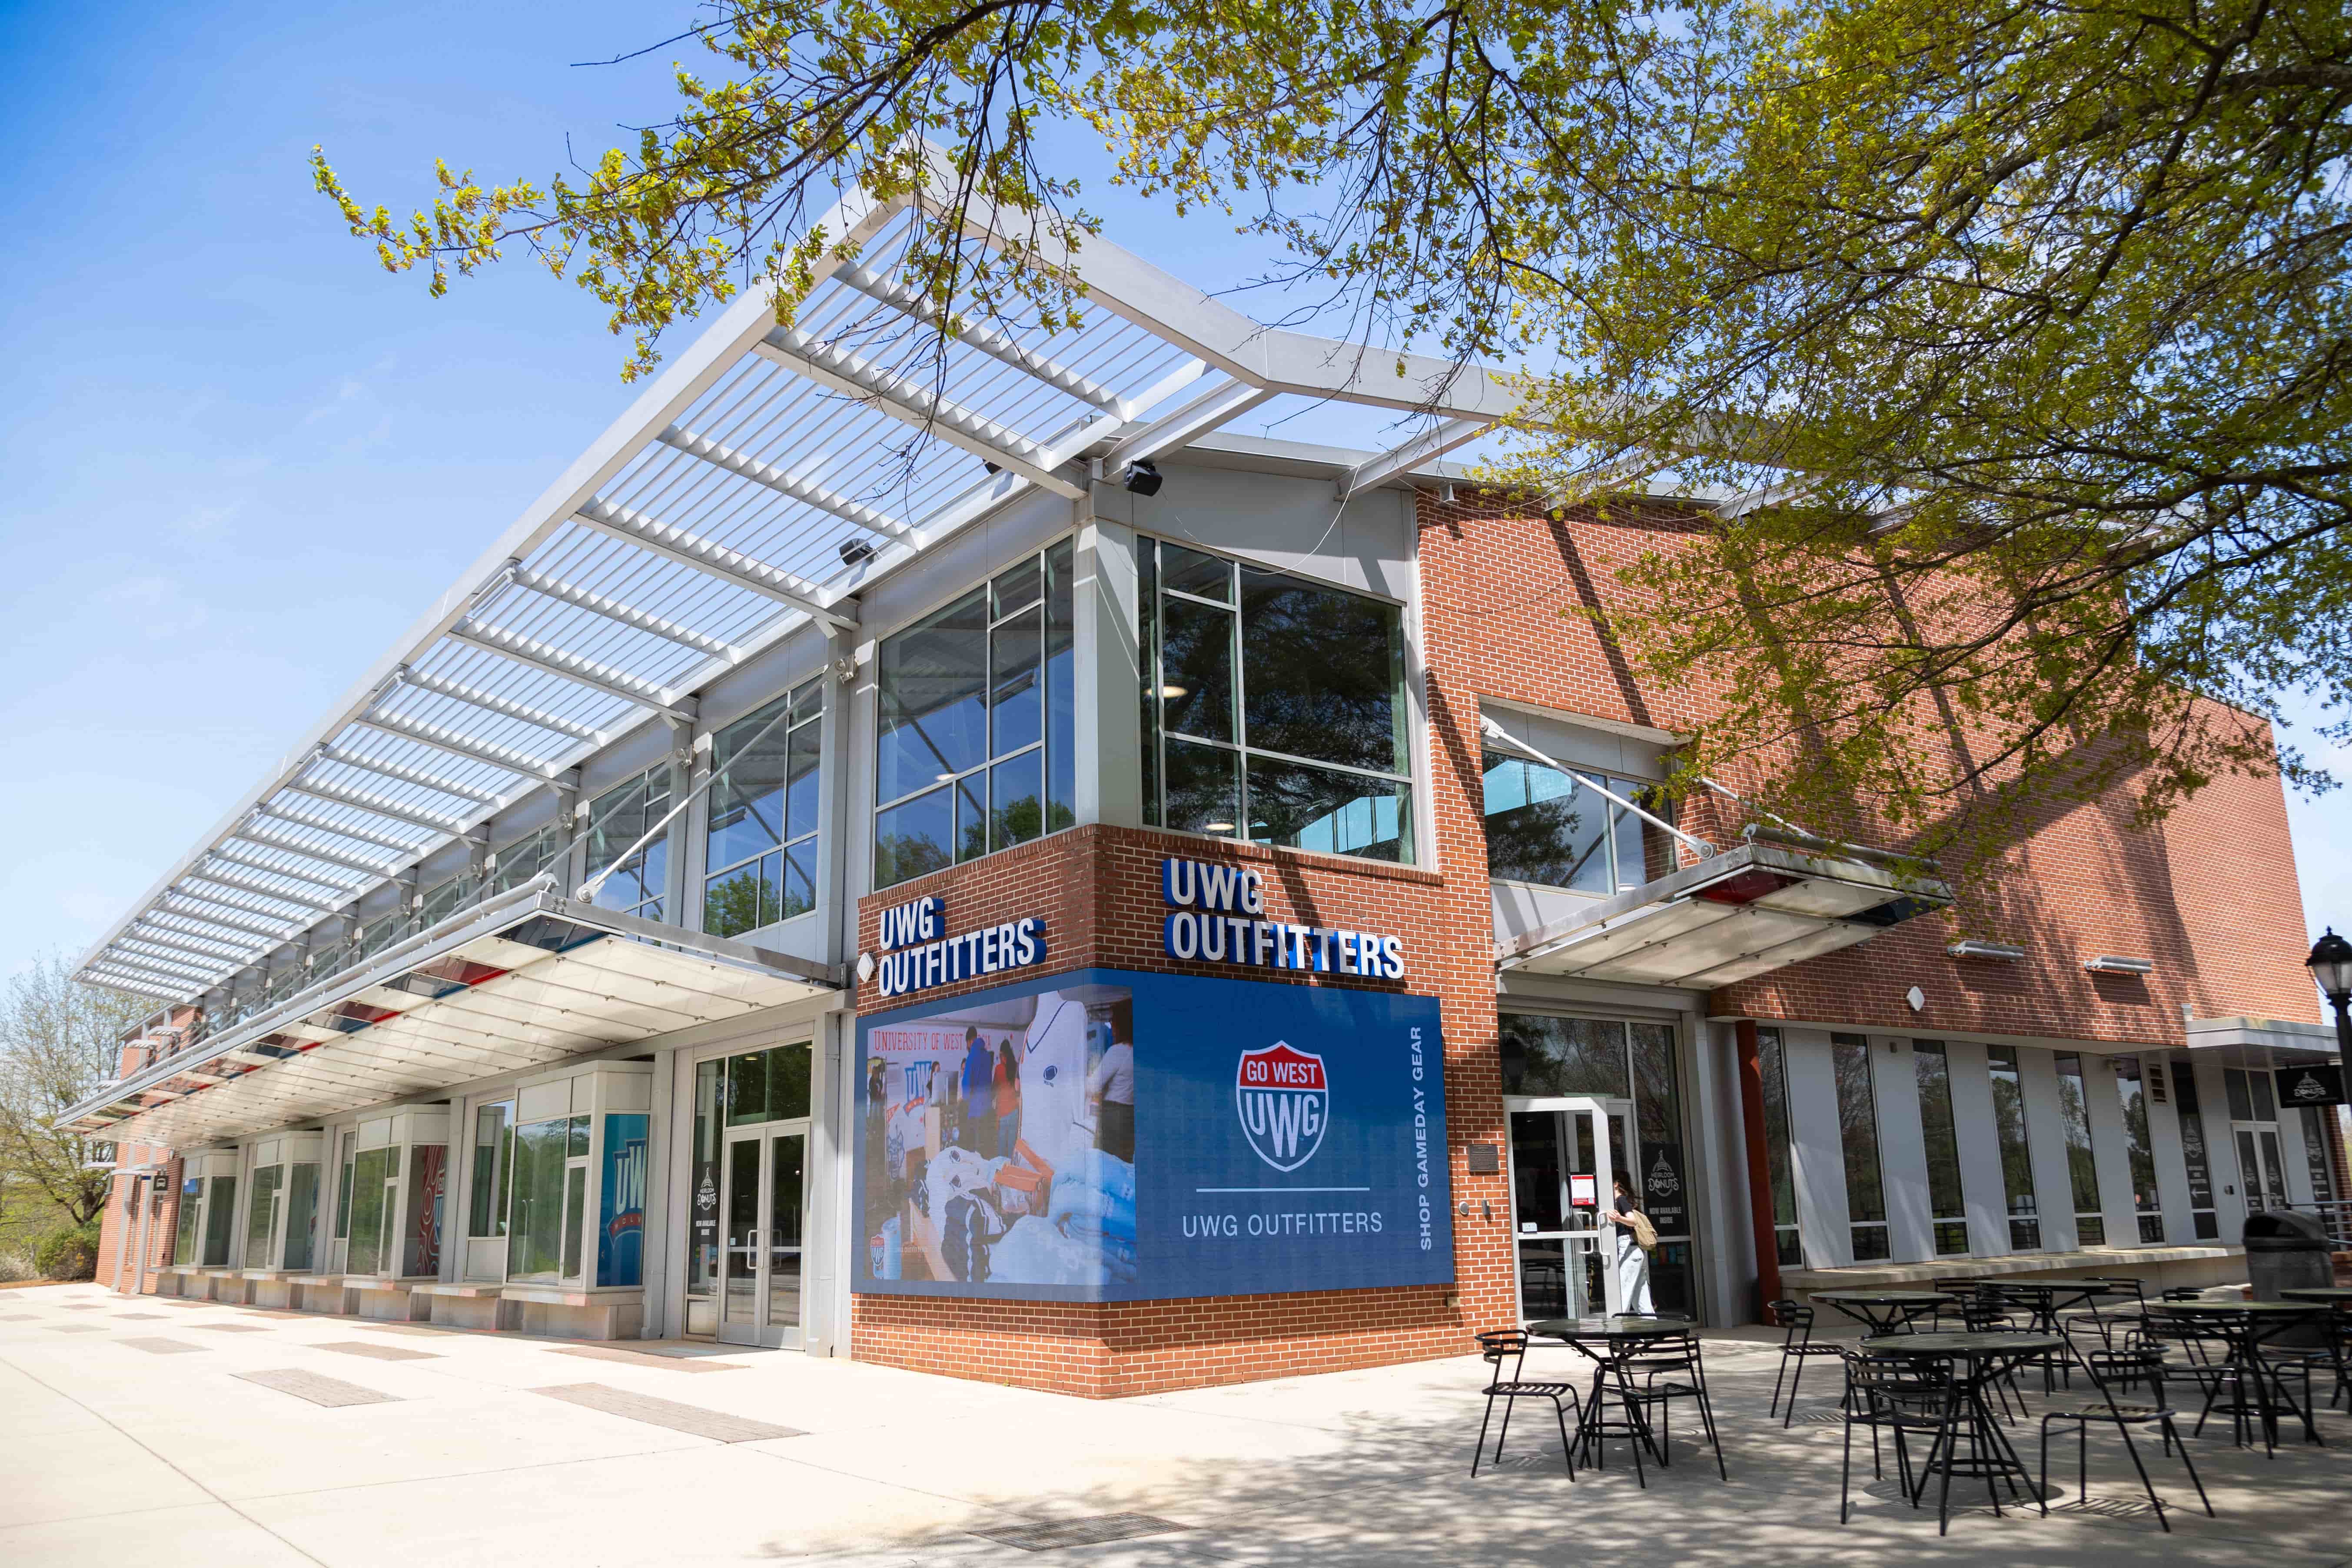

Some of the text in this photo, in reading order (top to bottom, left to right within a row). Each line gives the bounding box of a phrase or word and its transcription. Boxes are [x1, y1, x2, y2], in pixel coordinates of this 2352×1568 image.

[1171, 858, 1263, 914] UWG
[879, 897, 935, 950] UWG
[878, 917, 1036, 997] OUTFITTERS
[1173, 912, 1405, 980] OUTFITTERS
[874, 1031, 928, 1050] UNIVERSITY
[931, 1033, 940, 1050] OF
[943, 1033, 963, 1050] WEST
[1246, 1060, 1317, 1084] GO WEST
[1246, 1092, 1319, 1158] UWG
[1411, 1026, 1432, 1250] SHOP GAMEDAY GEAR
[697, 1193, 716, 1206] DONUTS
[1648, 1178, 1679, 1191] DONUTS
[1182, 1212, 1383, 1237] UWG OUTFITTERS
[872, 1247, 884, 1265] UWG
